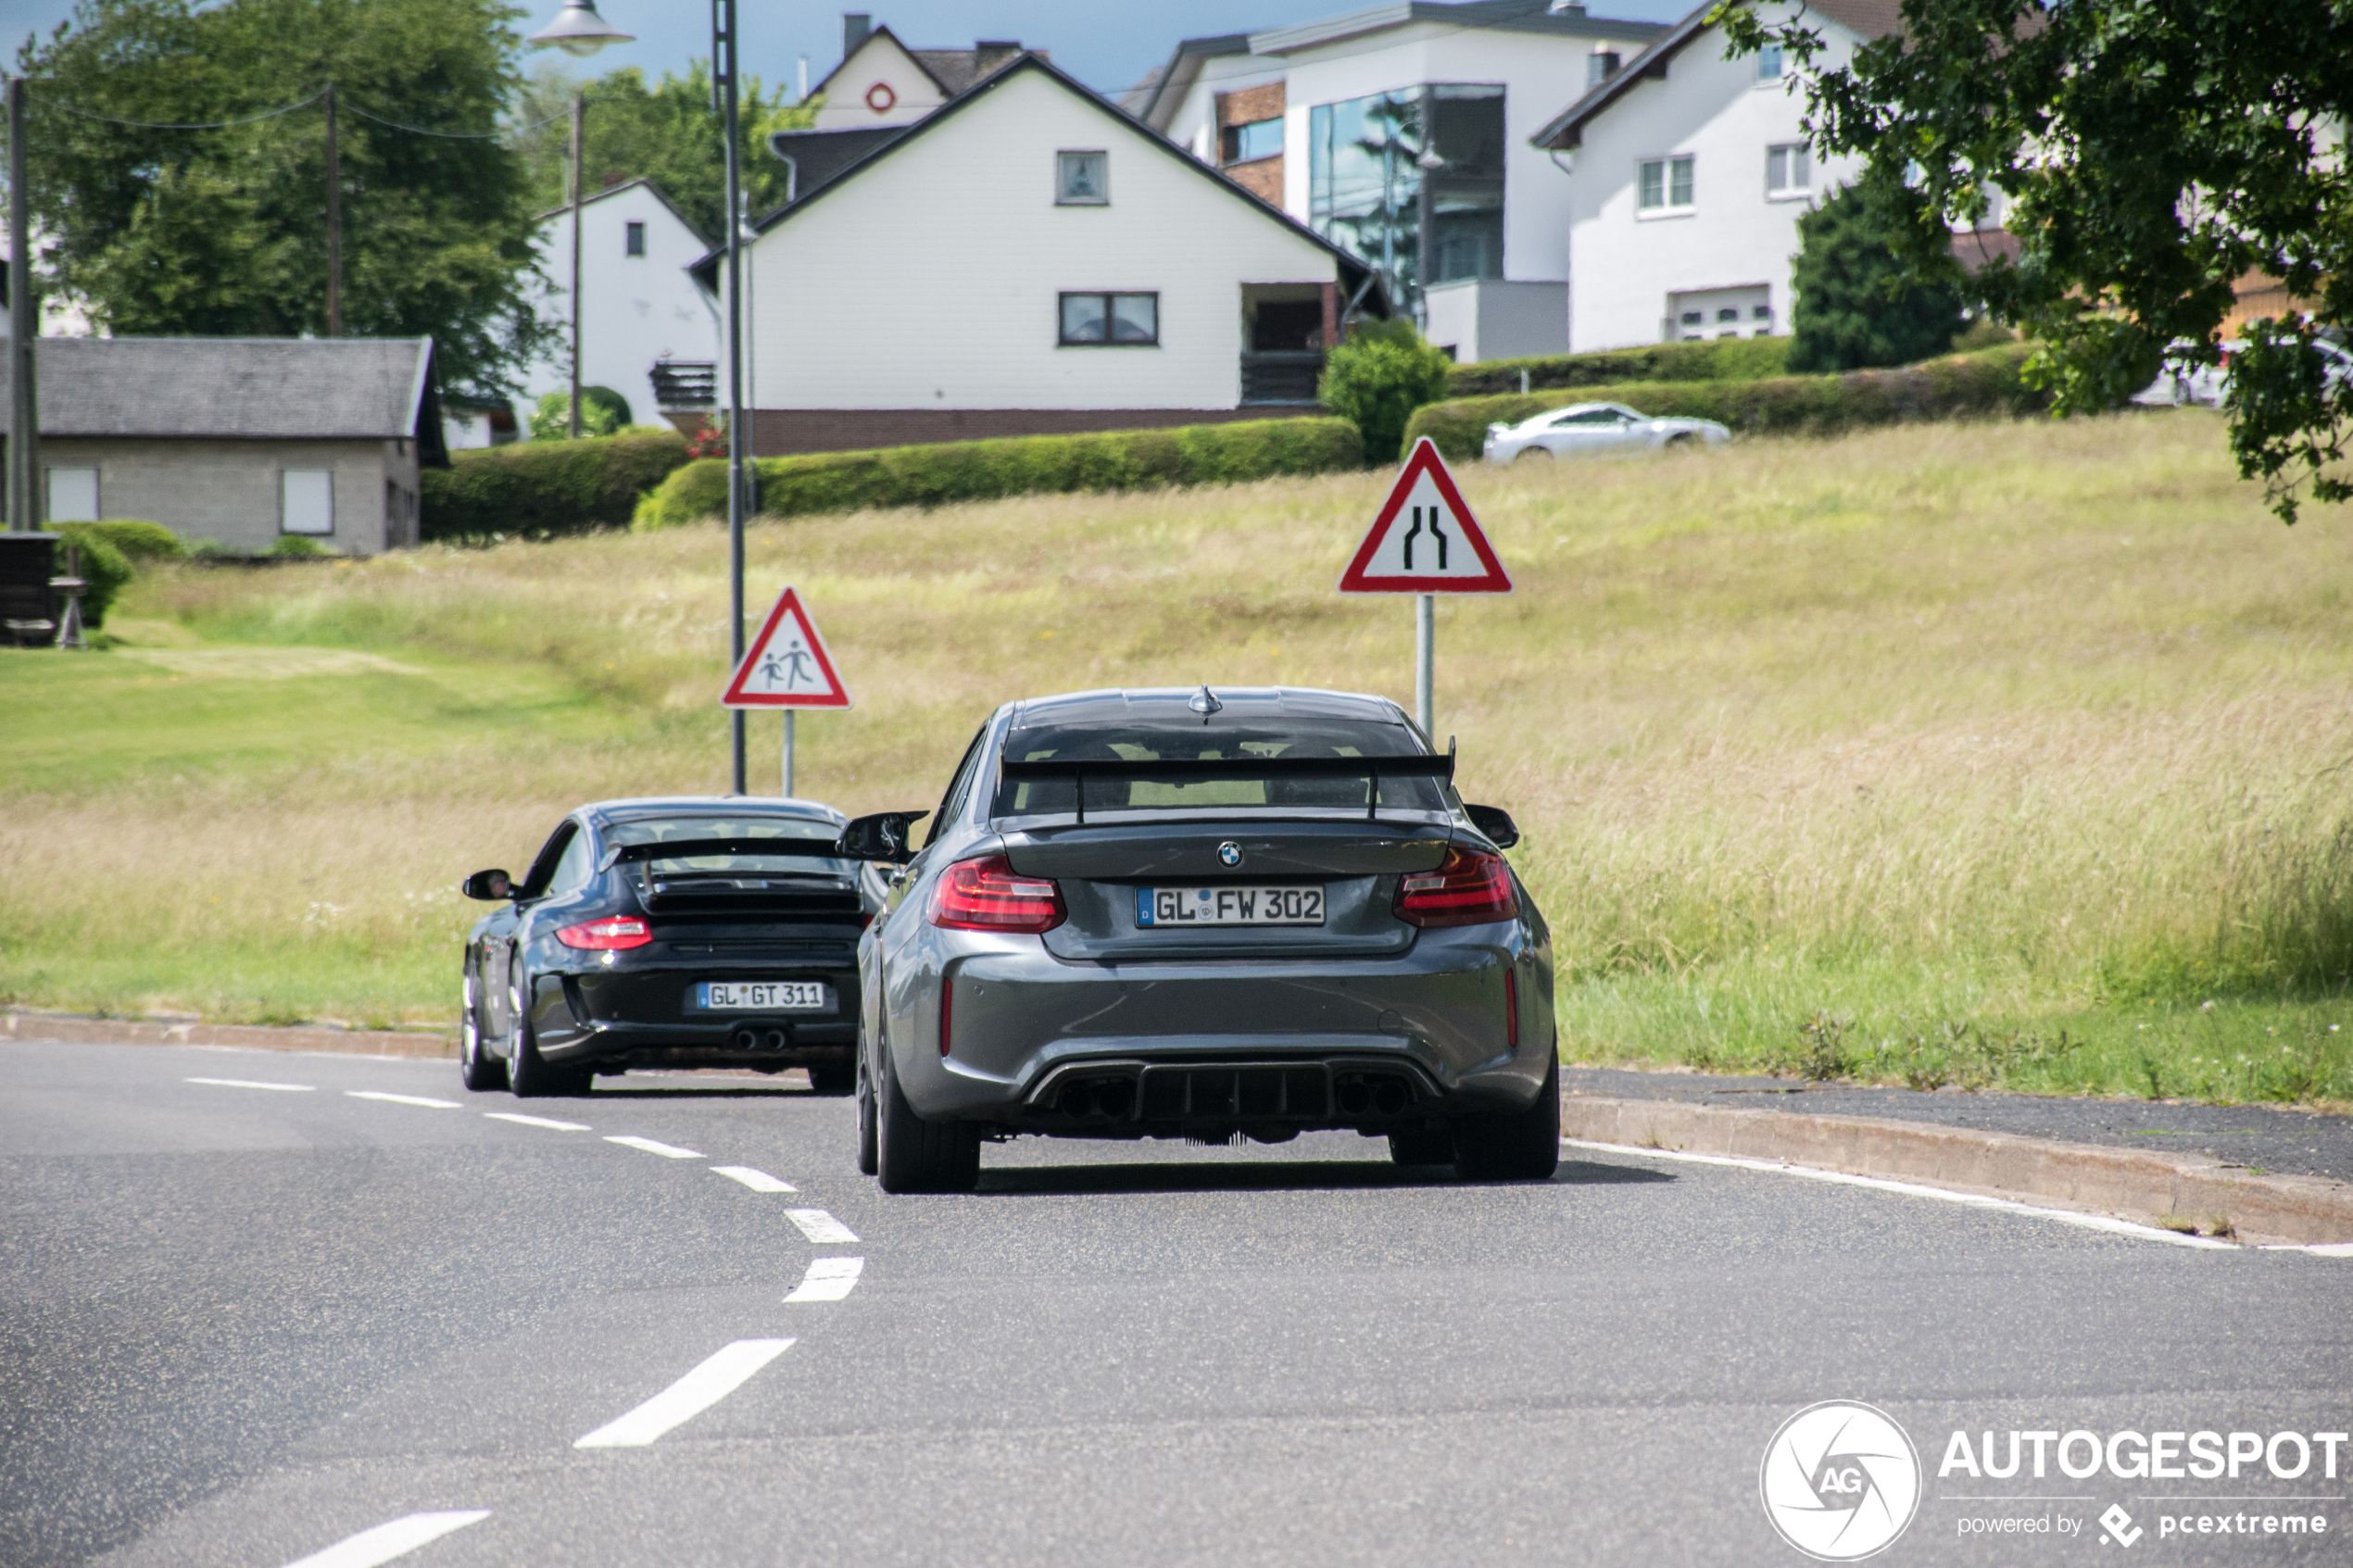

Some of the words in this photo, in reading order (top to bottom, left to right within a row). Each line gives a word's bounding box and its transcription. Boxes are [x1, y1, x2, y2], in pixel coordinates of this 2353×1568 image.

[1142, 910, 1149, 919] D
[1156, 891, 1196, 921] GL
[1216, 890, 1256, 919] FW
[1265, 890, 1321, 919] 302
[711, 986, 737, 1005] GL
[751, 985, 777, 1005] GT
[783, 985, 821, 1005] 311
